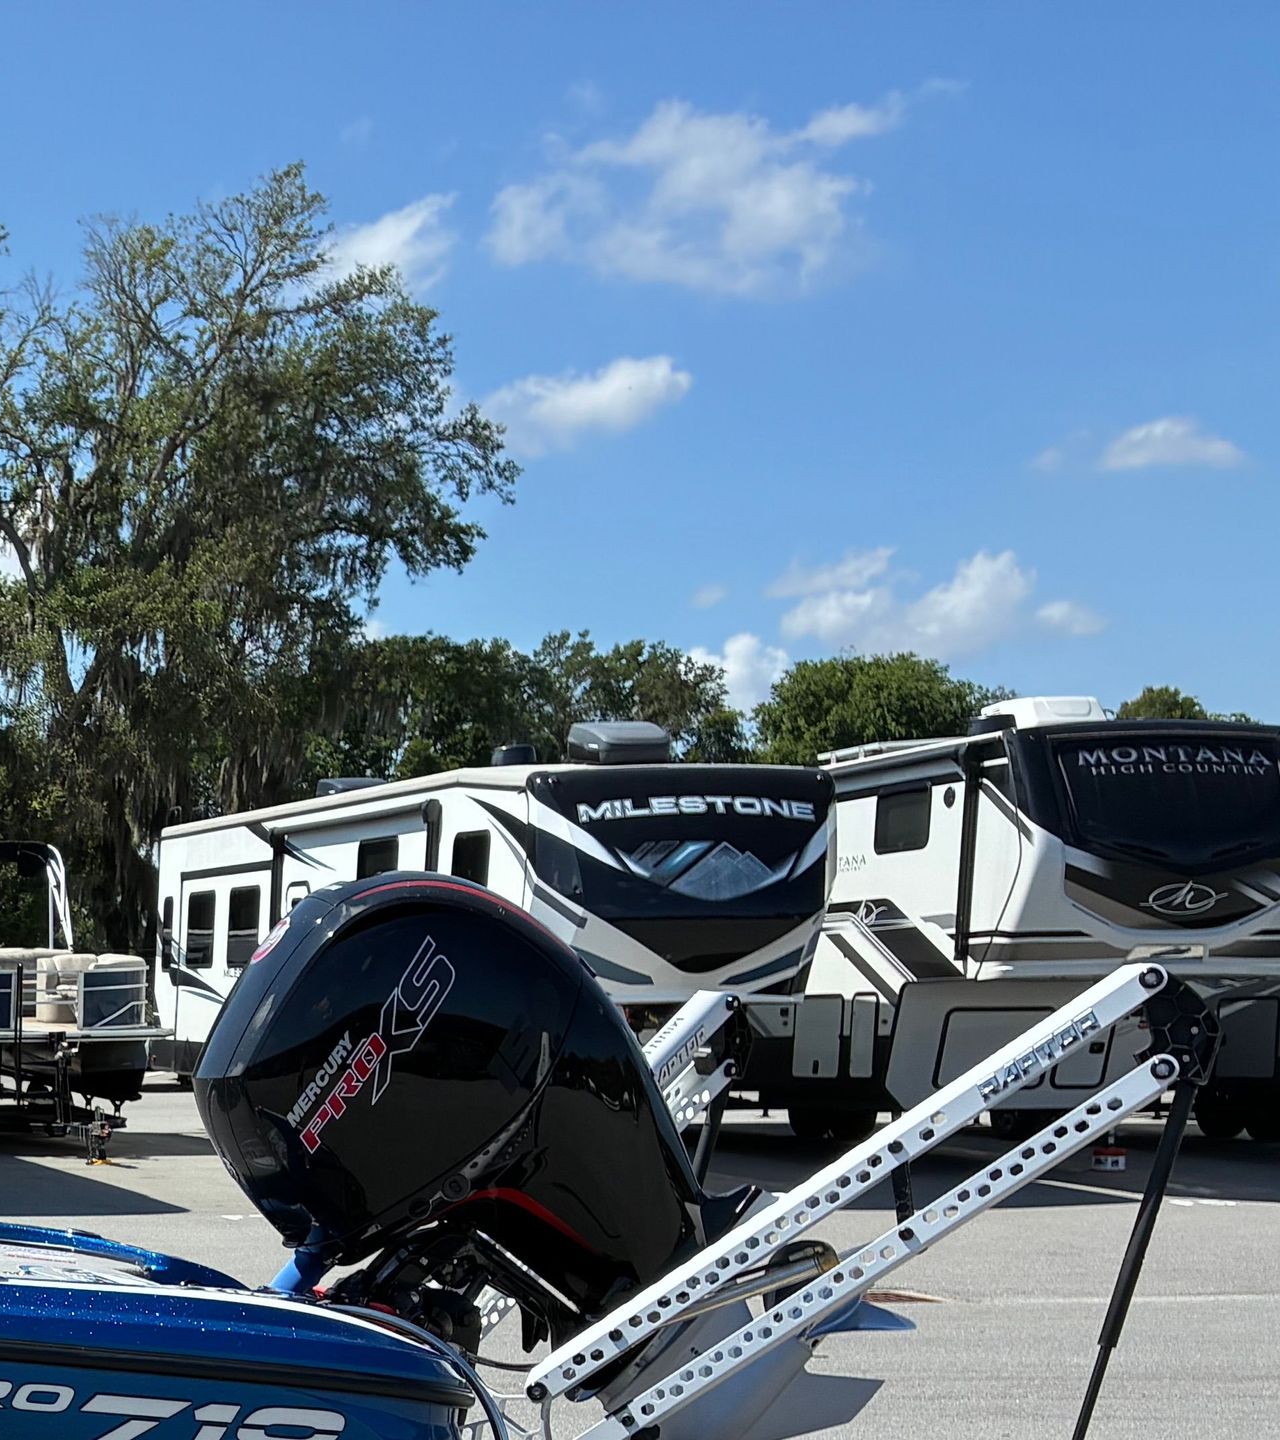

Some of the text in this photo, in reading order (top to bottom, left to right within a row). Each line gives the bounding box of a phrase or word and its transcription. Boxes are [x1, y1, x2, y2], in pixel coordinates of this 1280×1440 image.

[1078, 747, 1272, 766] MONTANA
[1091, 763, 1266, 776] HIGH COUNTRY
[576, 796, 816, 824] MILESTONE
[286, 1031, 353, 1128] MERCURY
